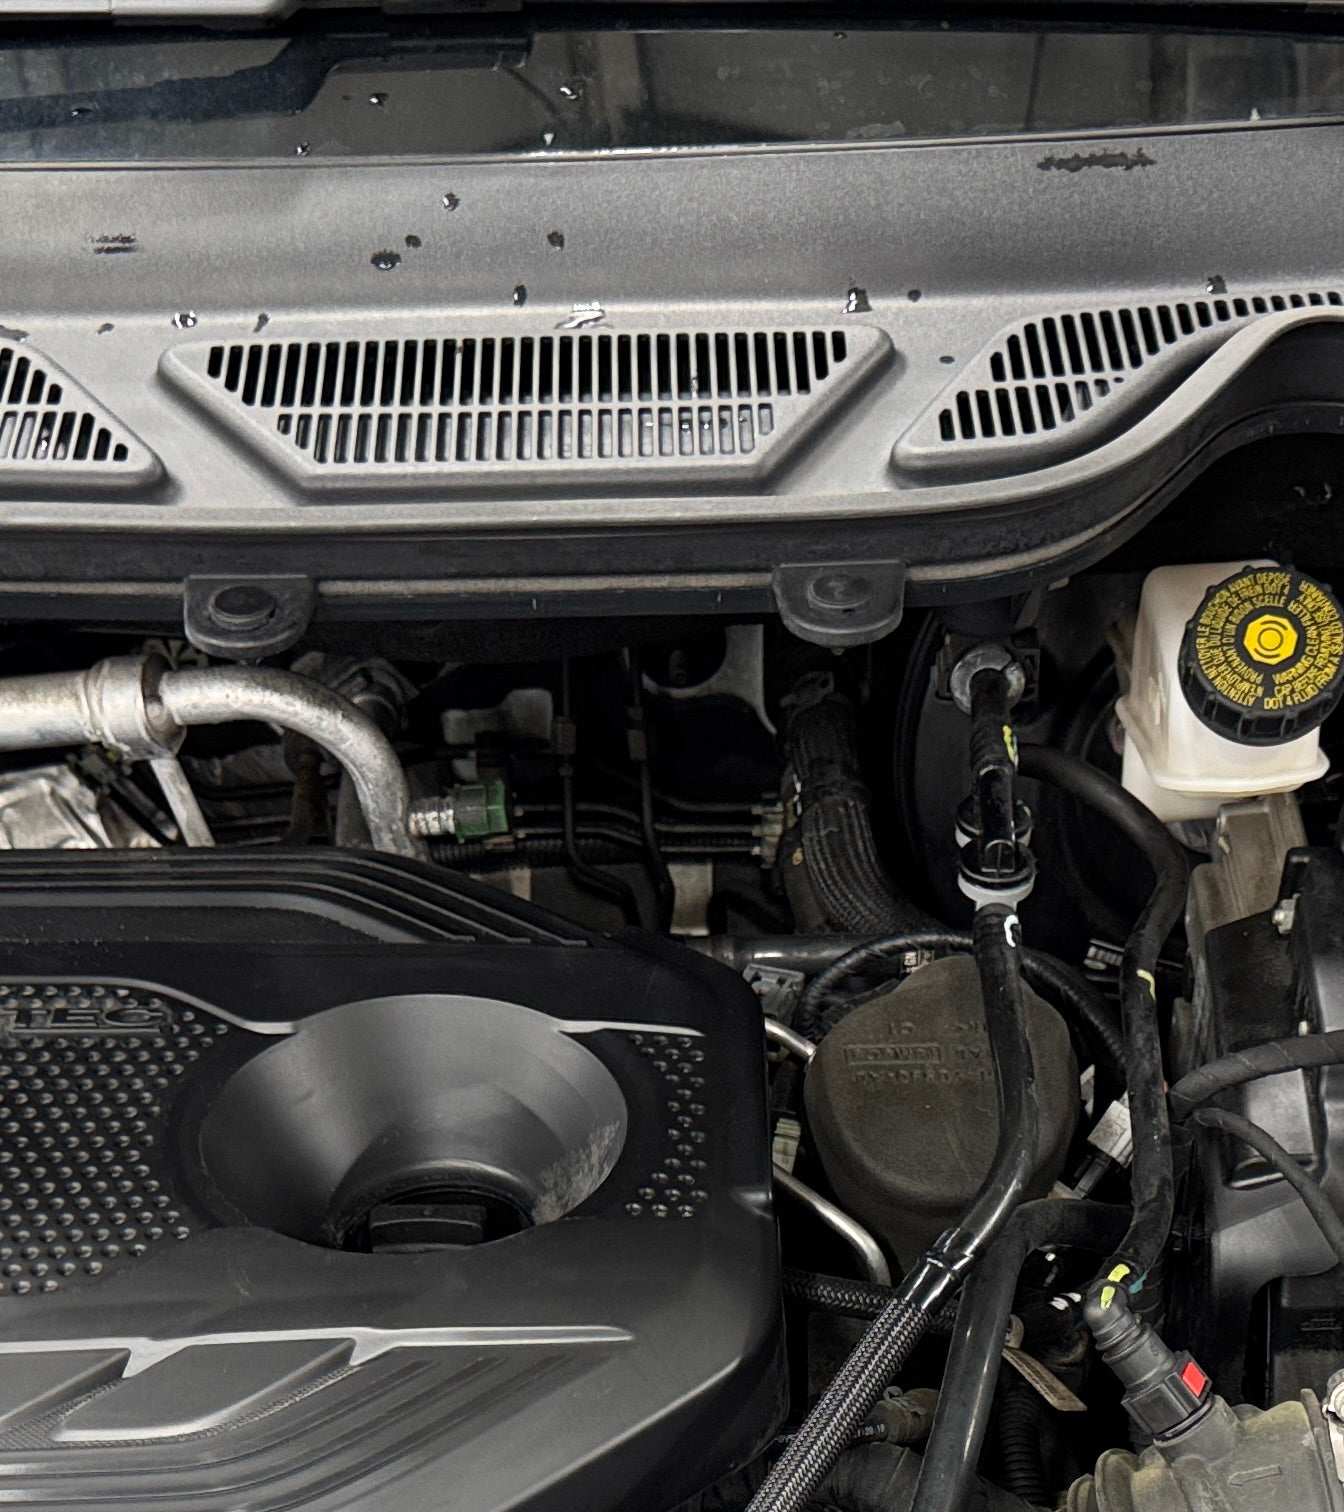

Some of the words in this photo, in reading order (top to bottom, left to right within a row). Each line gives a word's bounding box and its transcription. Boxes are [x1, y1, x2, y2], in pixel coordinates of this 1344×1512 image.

[1209, 634, 1221, 645] DU
[1226, 593, 1241, 607] DE
[1286, 598, 1315, 627] FILLER
[1197, 623, 1210, 636] LE
[1304, 625, 1318, 656] CLEAN
[1262, 697, 1284, 709] DOT
